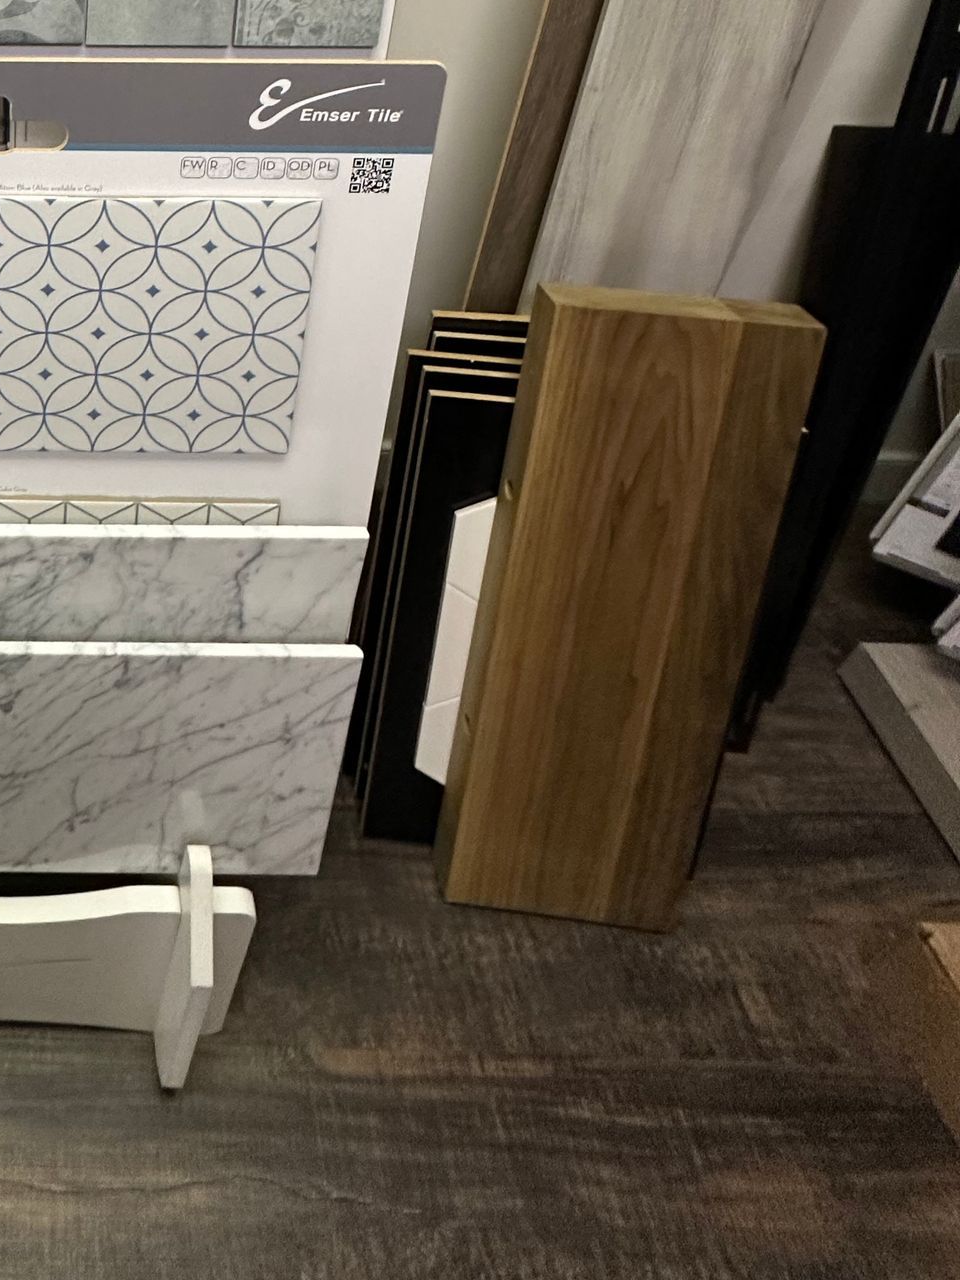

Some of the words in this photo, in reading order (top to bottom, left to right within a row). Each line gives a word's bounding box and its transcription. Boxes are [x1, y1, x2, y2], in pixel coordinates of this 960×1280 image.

[299, 108, 360, 122] Emser
[182, 160, 205, 171] FW
[210, 160, 218, 171] R
[236, 160, 246, 171] C
[262, 160, 275, 171] ID
[289, 160, 310, 171] OD
[318, 160, 334, 171] PL
